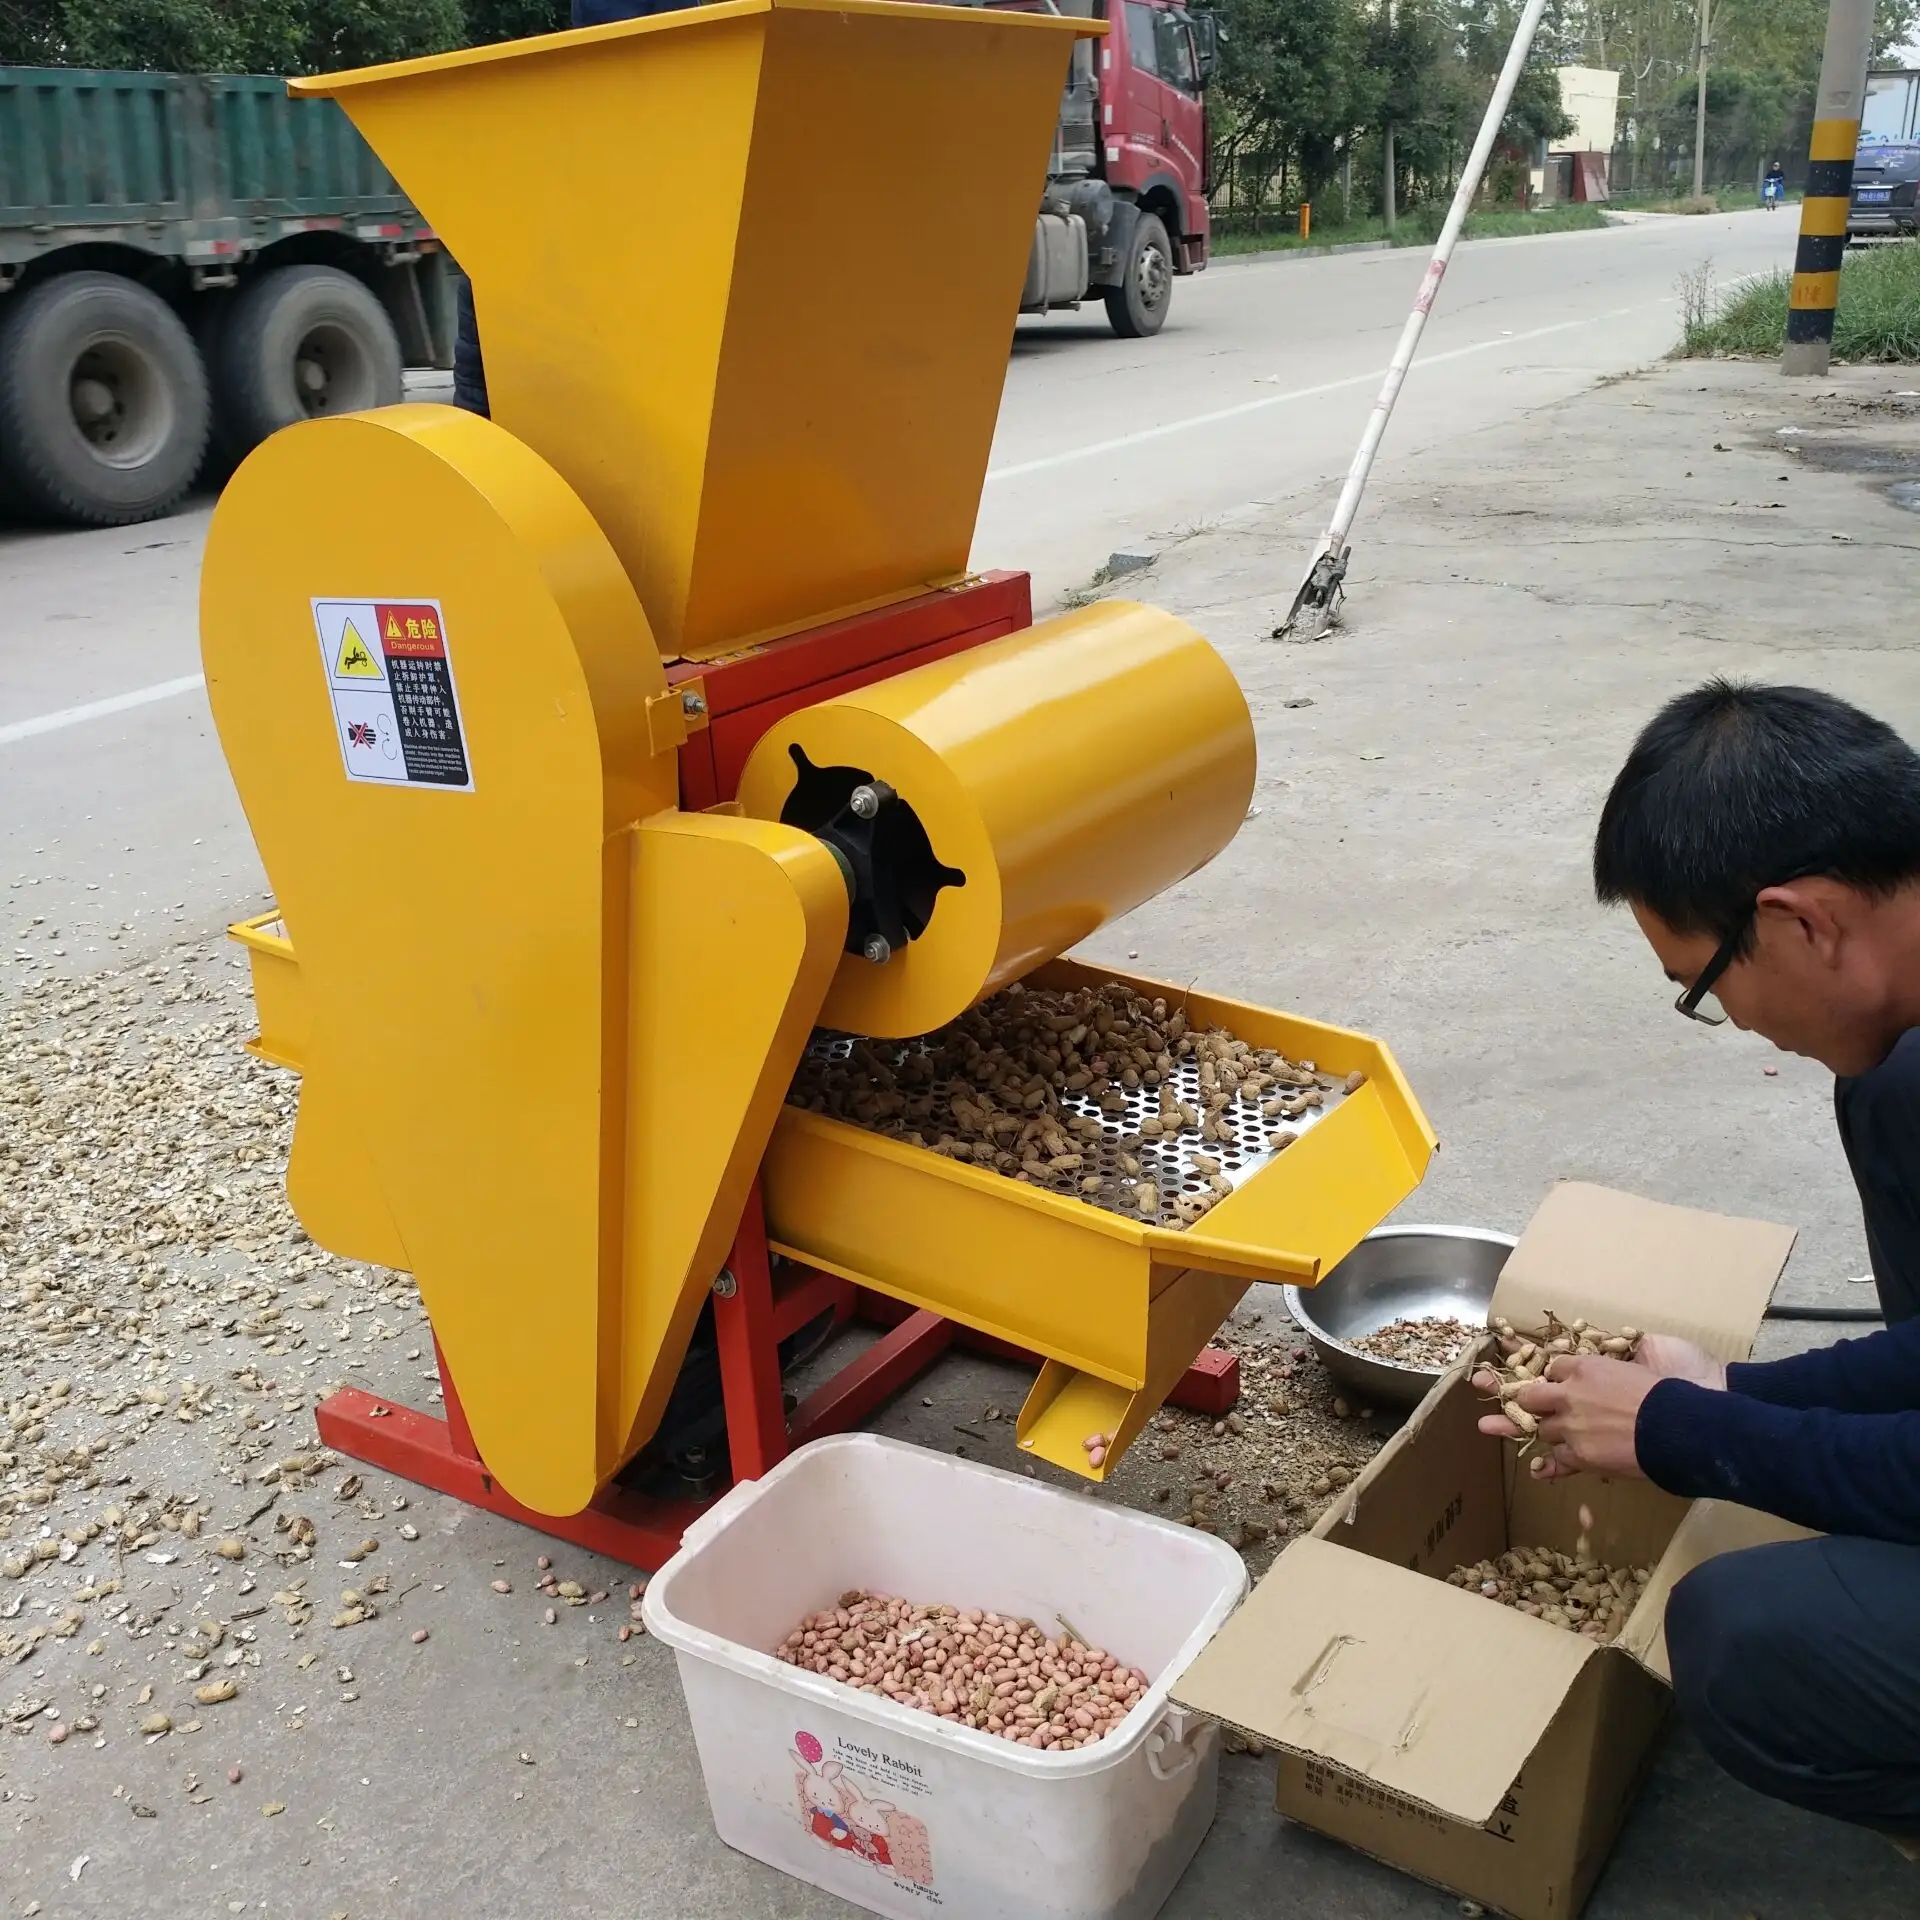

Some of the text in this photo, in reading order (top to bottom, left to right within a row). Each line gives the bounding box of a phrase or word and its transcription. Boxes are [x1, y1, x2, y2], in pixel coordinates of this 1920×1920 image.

[405, 617, 438, 639] 危险
[391, 641, 435, 652] Dangerous
[838, 1736, 878, 1762] Lovely
[882, 1753, 924, 1778] Rabbit
